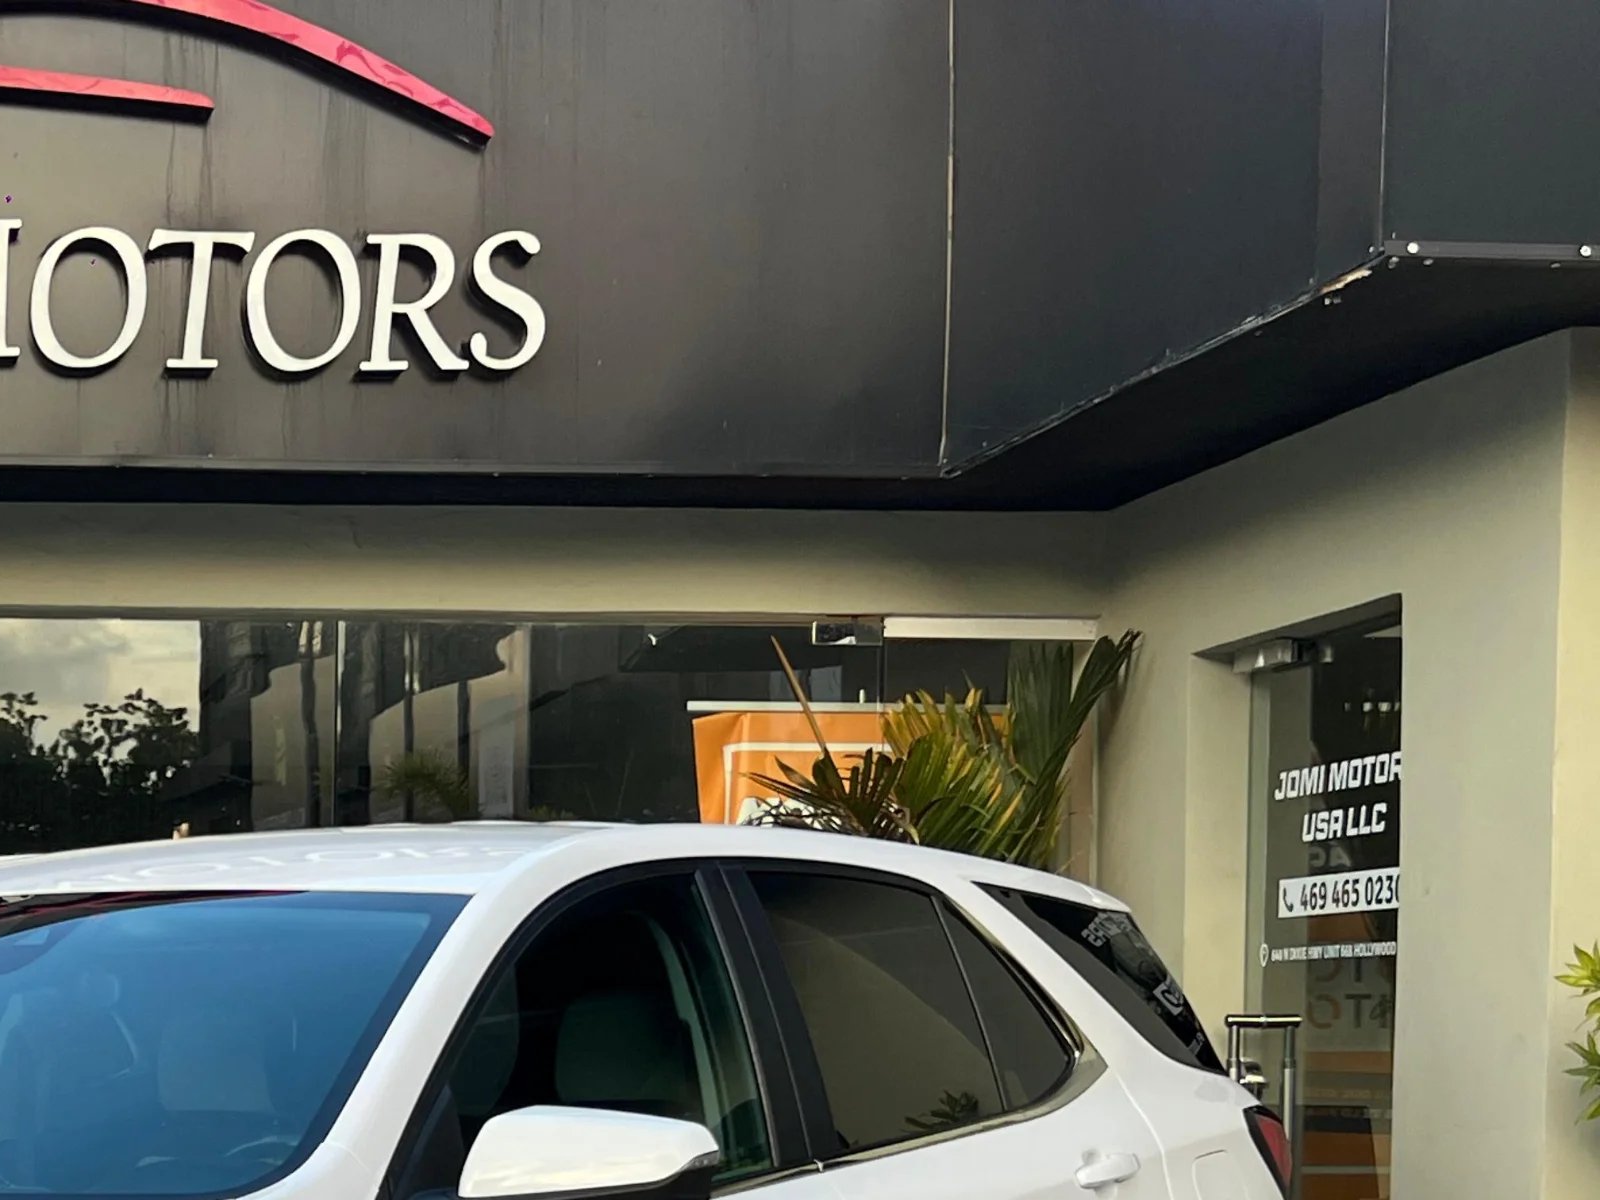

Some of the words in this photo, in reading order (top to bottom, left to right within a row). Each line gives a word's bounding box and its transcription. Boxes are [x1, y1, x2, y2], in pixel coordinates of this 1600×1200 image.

[1274, 764, 1326, 800] JOMI
[1302, 808, 1344, 842] USA
[1346, 802, 1388, 836] LLC
[1300, 881, 1327, 911] 469
[1332, 878, 1360, 908] 465
[1353, 941, 1397, 957] HOLLYWOOD
